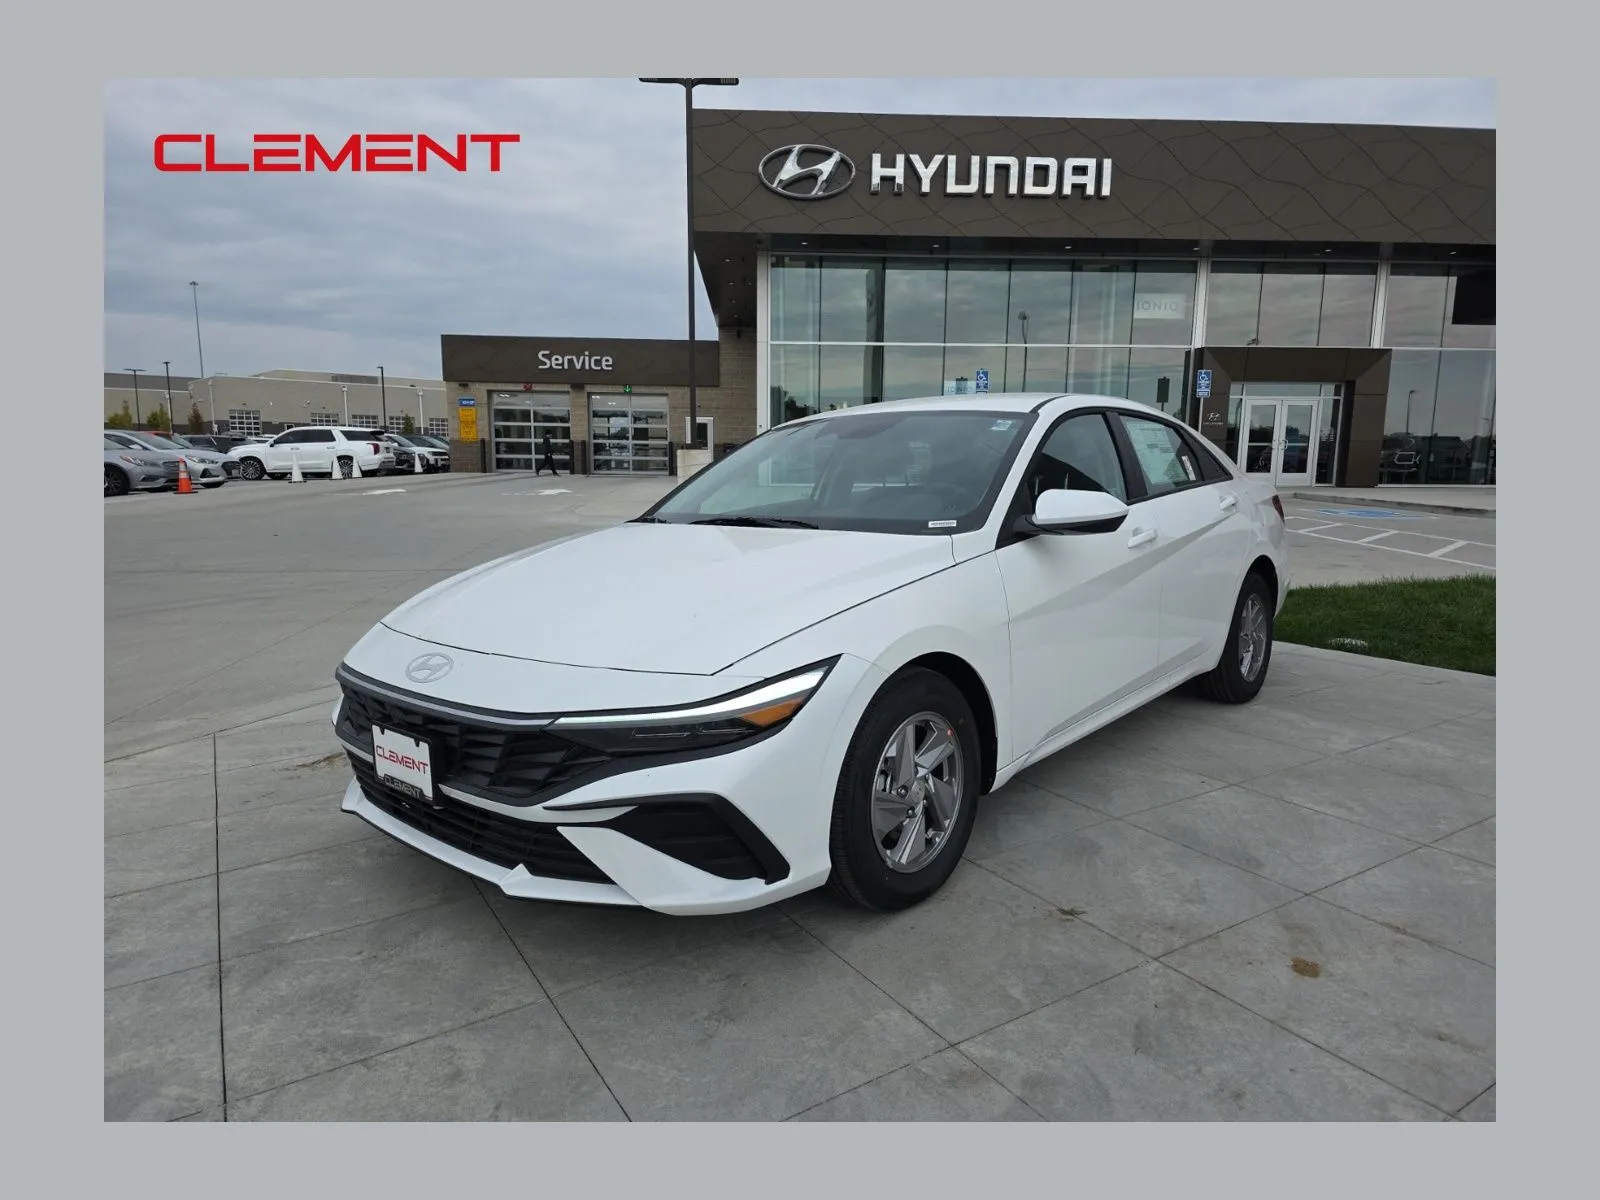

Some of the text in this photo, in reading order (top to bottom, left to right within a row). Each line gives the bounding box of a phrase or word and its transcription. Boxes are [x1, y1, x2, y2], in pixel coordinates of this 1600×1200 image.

[870, 153, 1112, 198] HYUNDAI
[537, 350, 613, 370] Service
[376, 745, 428, 774] CLEMENT
[384, 775, 421, 799] CLEMENT
